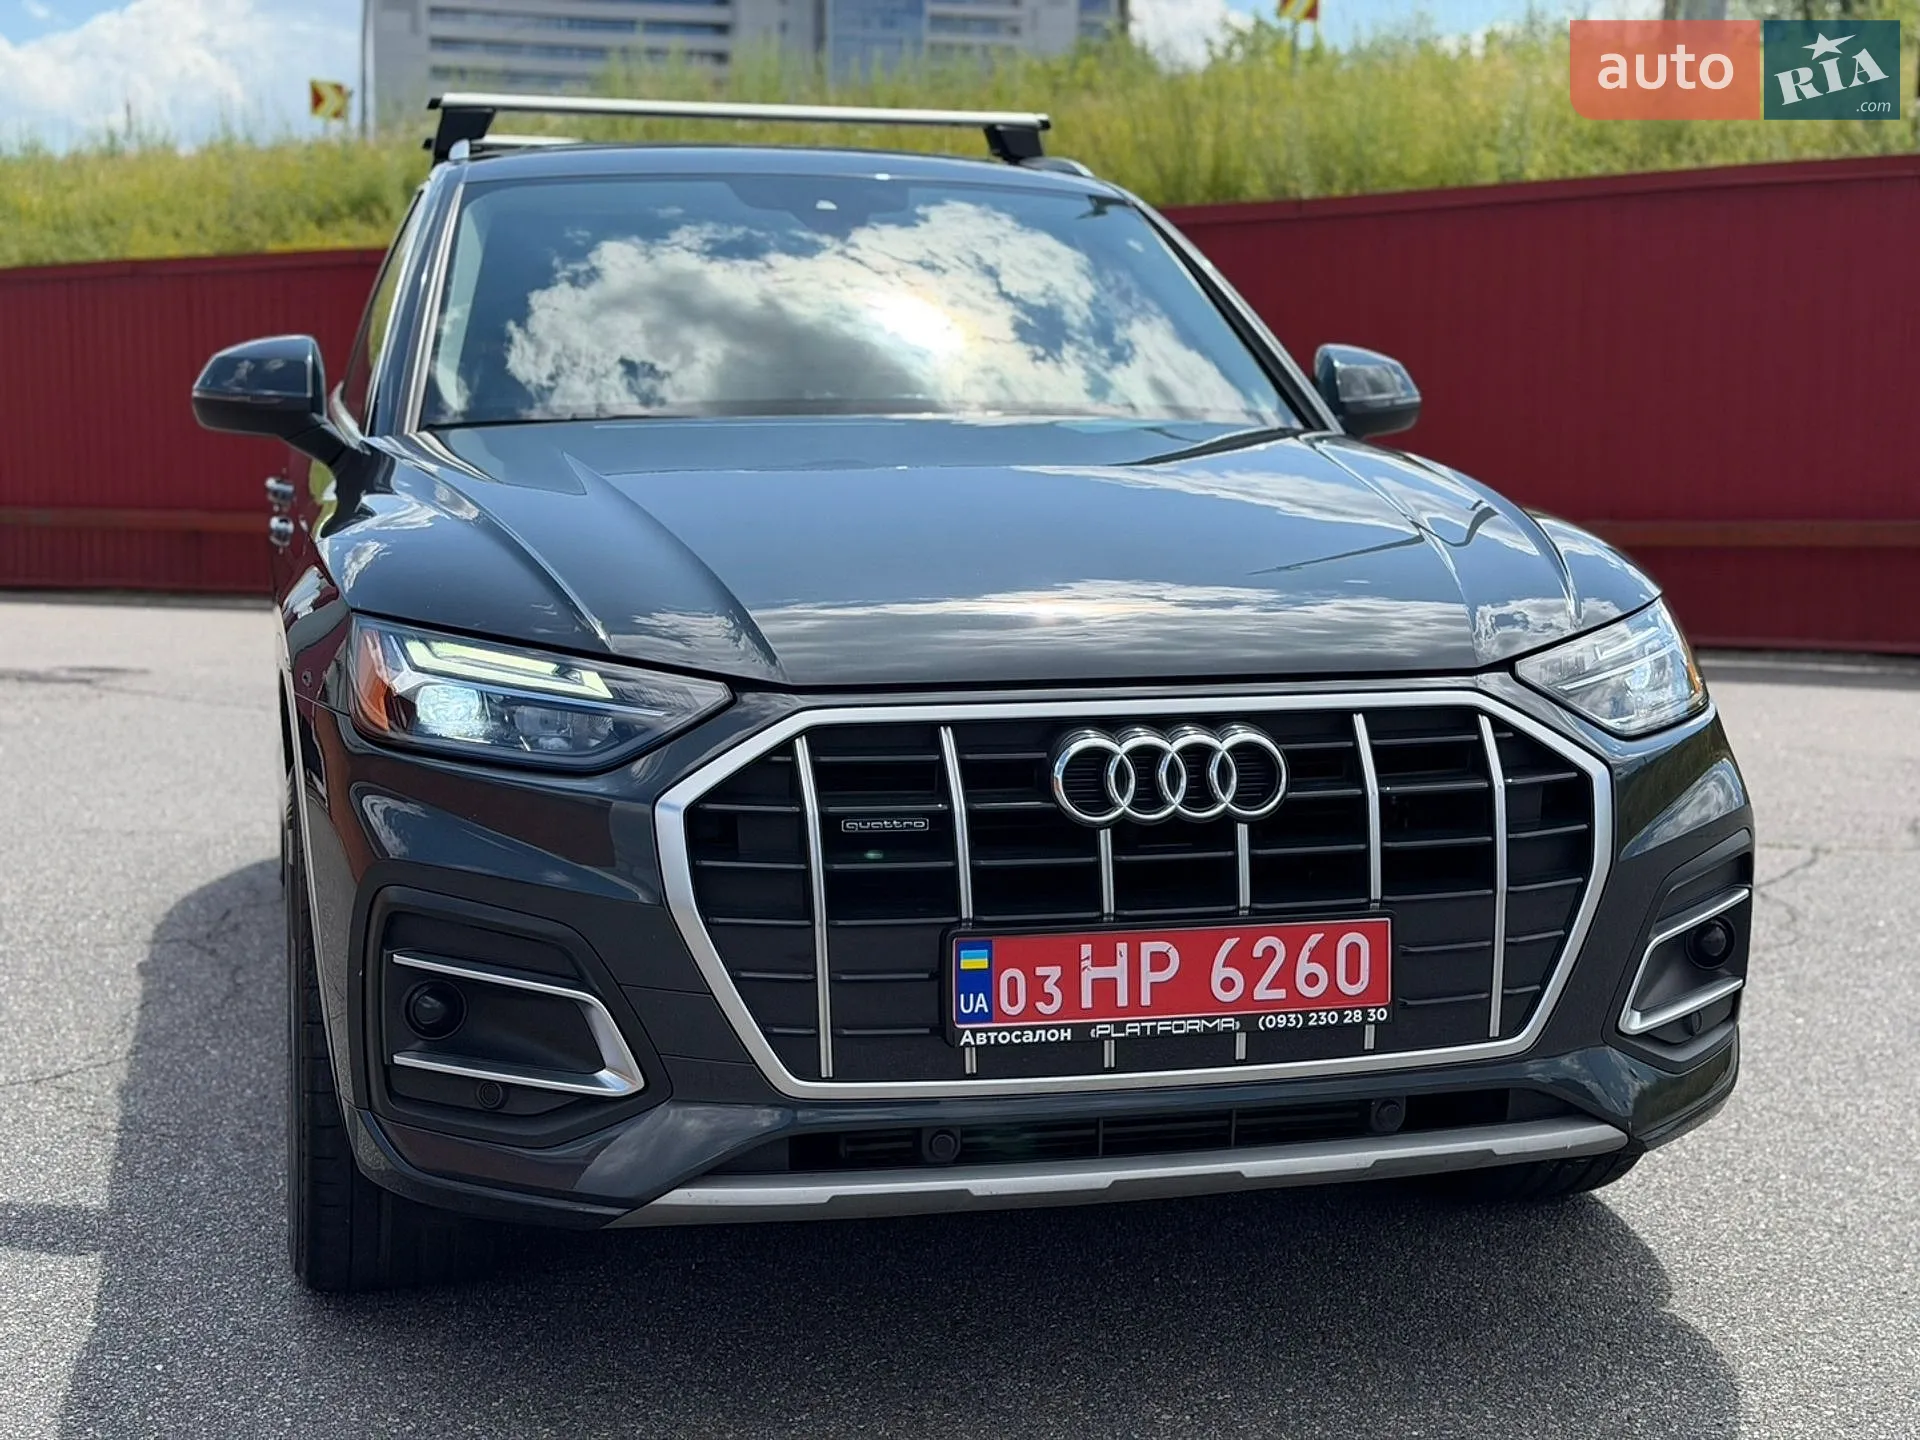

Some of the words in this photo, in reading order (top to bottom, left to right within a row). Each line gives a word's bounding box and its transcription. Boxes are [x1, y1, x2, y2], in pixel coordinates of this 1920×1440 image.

[845, 820, 925, 832] quattro
[999, 966, 1063, 1016] 03
[1080, 942, 1180, 1009] HP
[1210, 932, 1370, 1003] 6260
[960, 993, 989, 1014] UA
[1258, 1014, 1303, 1031] (093)
[1308, 1011, 1338, 1026] 230
[1343, 1009, 1363, 1023] 28
[1367, 1007, 1388, 1021] 30
[960, 1028, 1072, 1046] Автосалон
